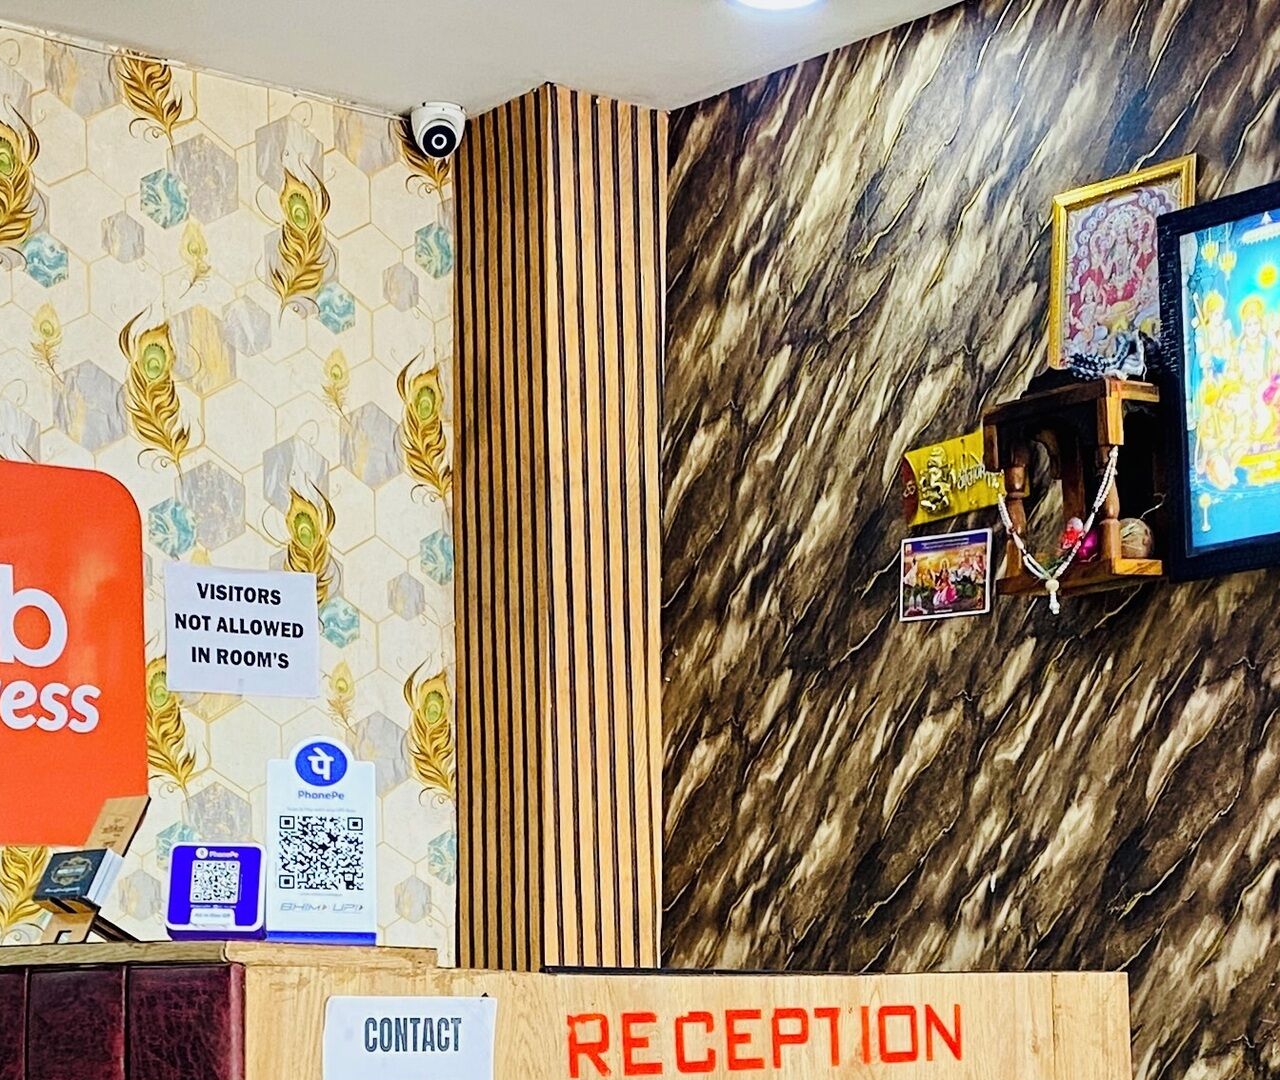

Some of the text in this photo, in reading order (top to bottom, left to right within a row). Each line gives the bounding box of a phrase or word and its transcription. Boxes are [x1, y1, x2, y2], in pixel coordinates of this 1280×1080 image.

[197, 583, 281, 605] VISITORS
[175, 613, 303, 638] NOT ALLOWED
[192, 647, 289, 668] IN ROOM'S
[298, 790, 345, 800] PhonePe
[365, 1018, 461, 1052] CONTACT
[567, 1005, 962, 1078] RECEPTION
